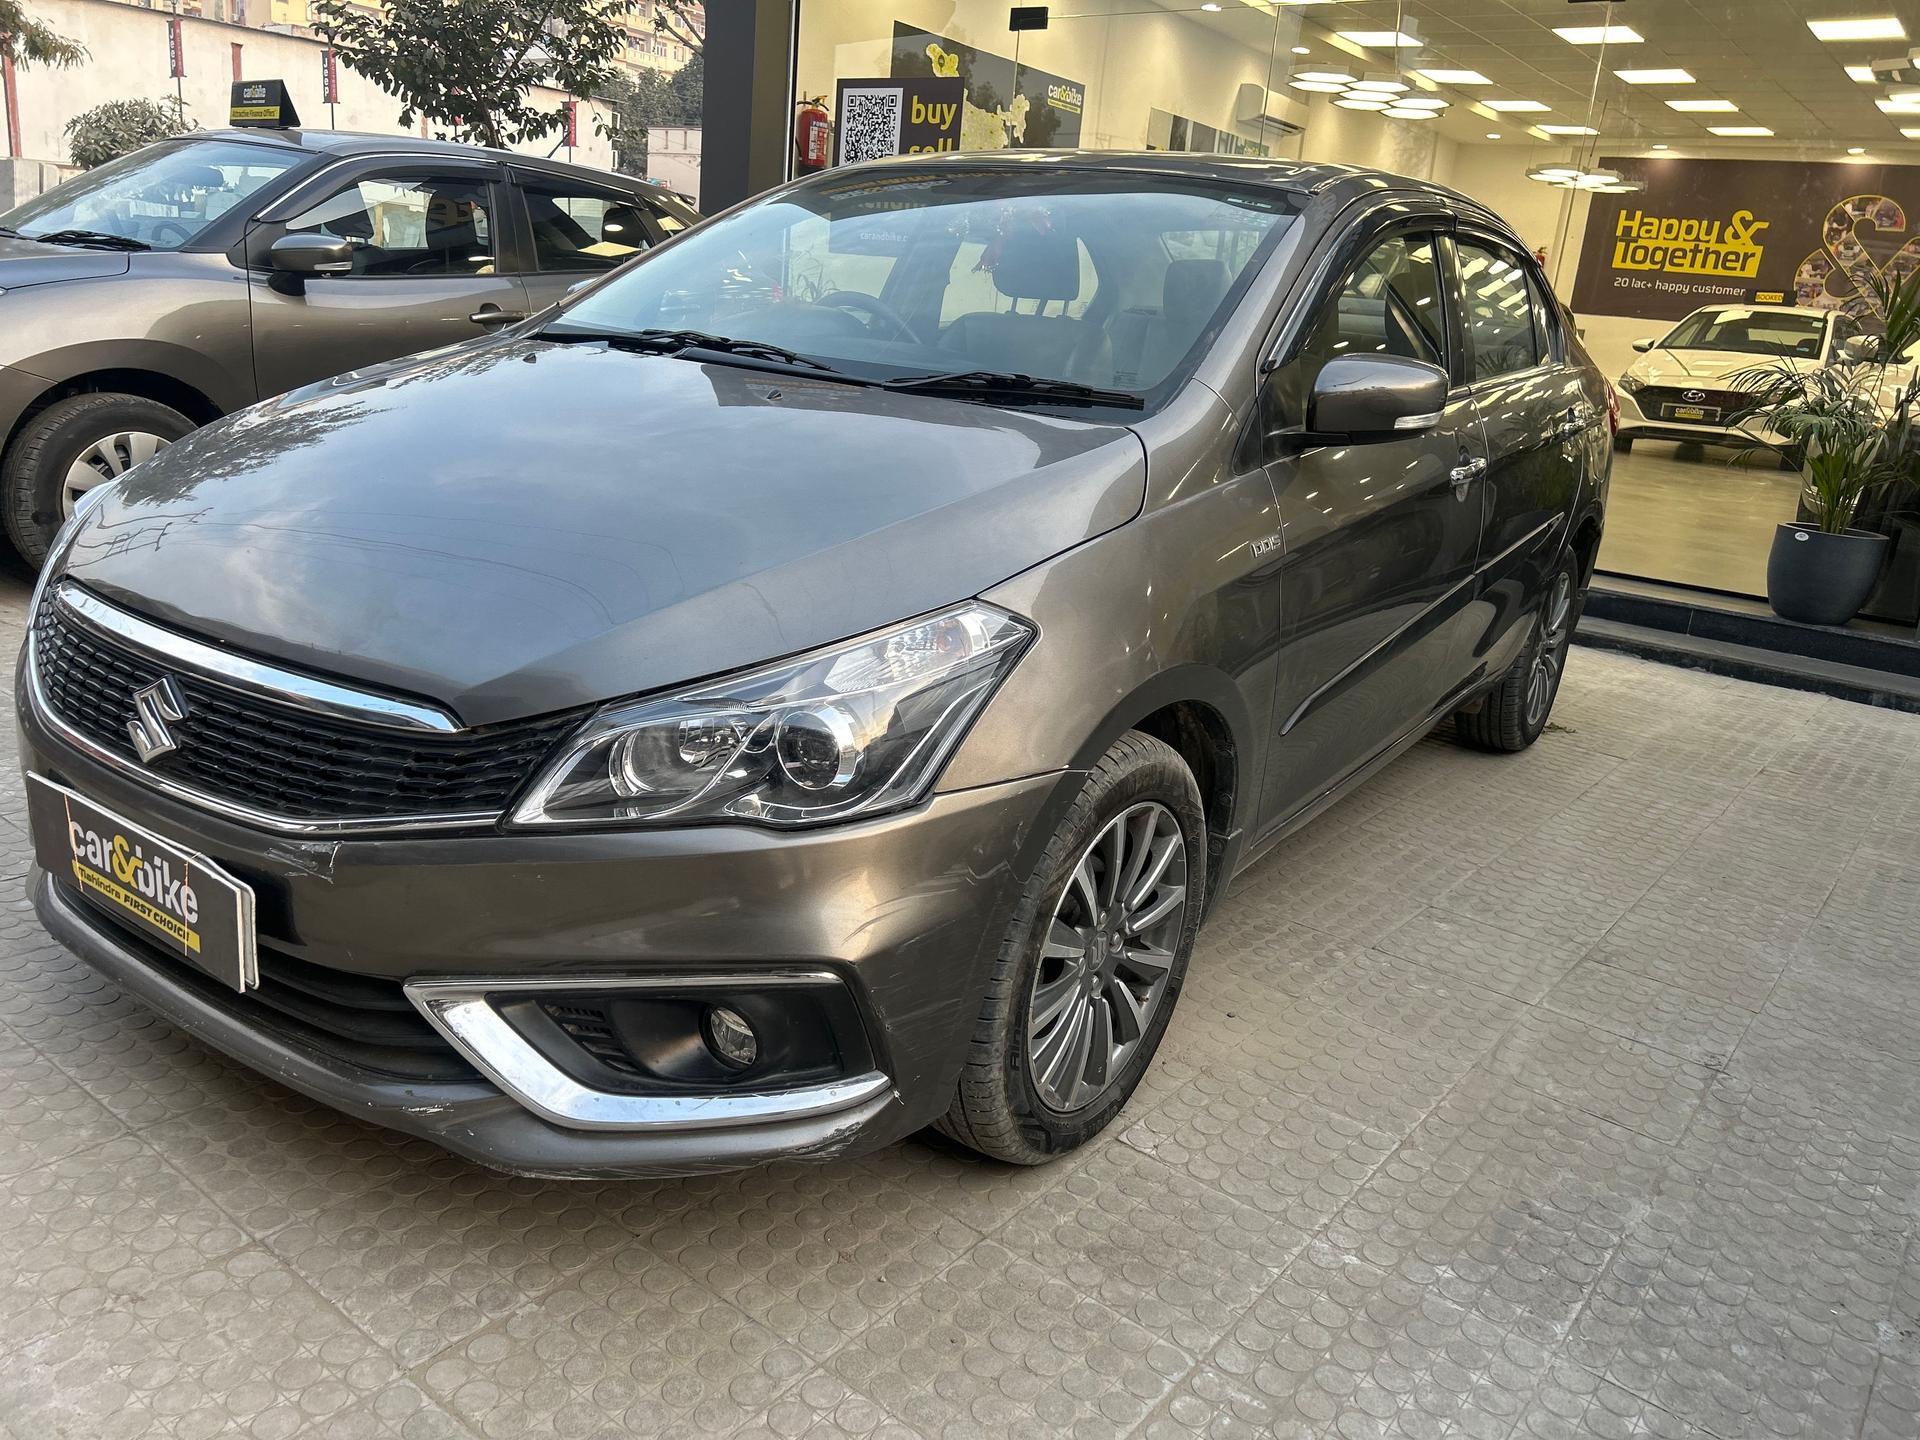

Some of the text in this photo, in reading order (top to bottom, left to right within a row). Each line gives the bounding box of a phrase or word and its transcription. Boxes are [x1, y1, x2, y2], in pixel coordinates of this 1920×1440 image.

[1048, 84, 1082, 106] car&bike
[911, 95, 957, 131] buy
[1615, 209, 1770, 246] Happy &
[1617, 238, 1756, 272] Together
[1613, 277, 1746, 297] 20 lac+ happy customer
[1756, 293, 1783, 302] BOOKED
[70, 821, 199, 924] car&bike
[124, 893, 153, 918] FIRST
